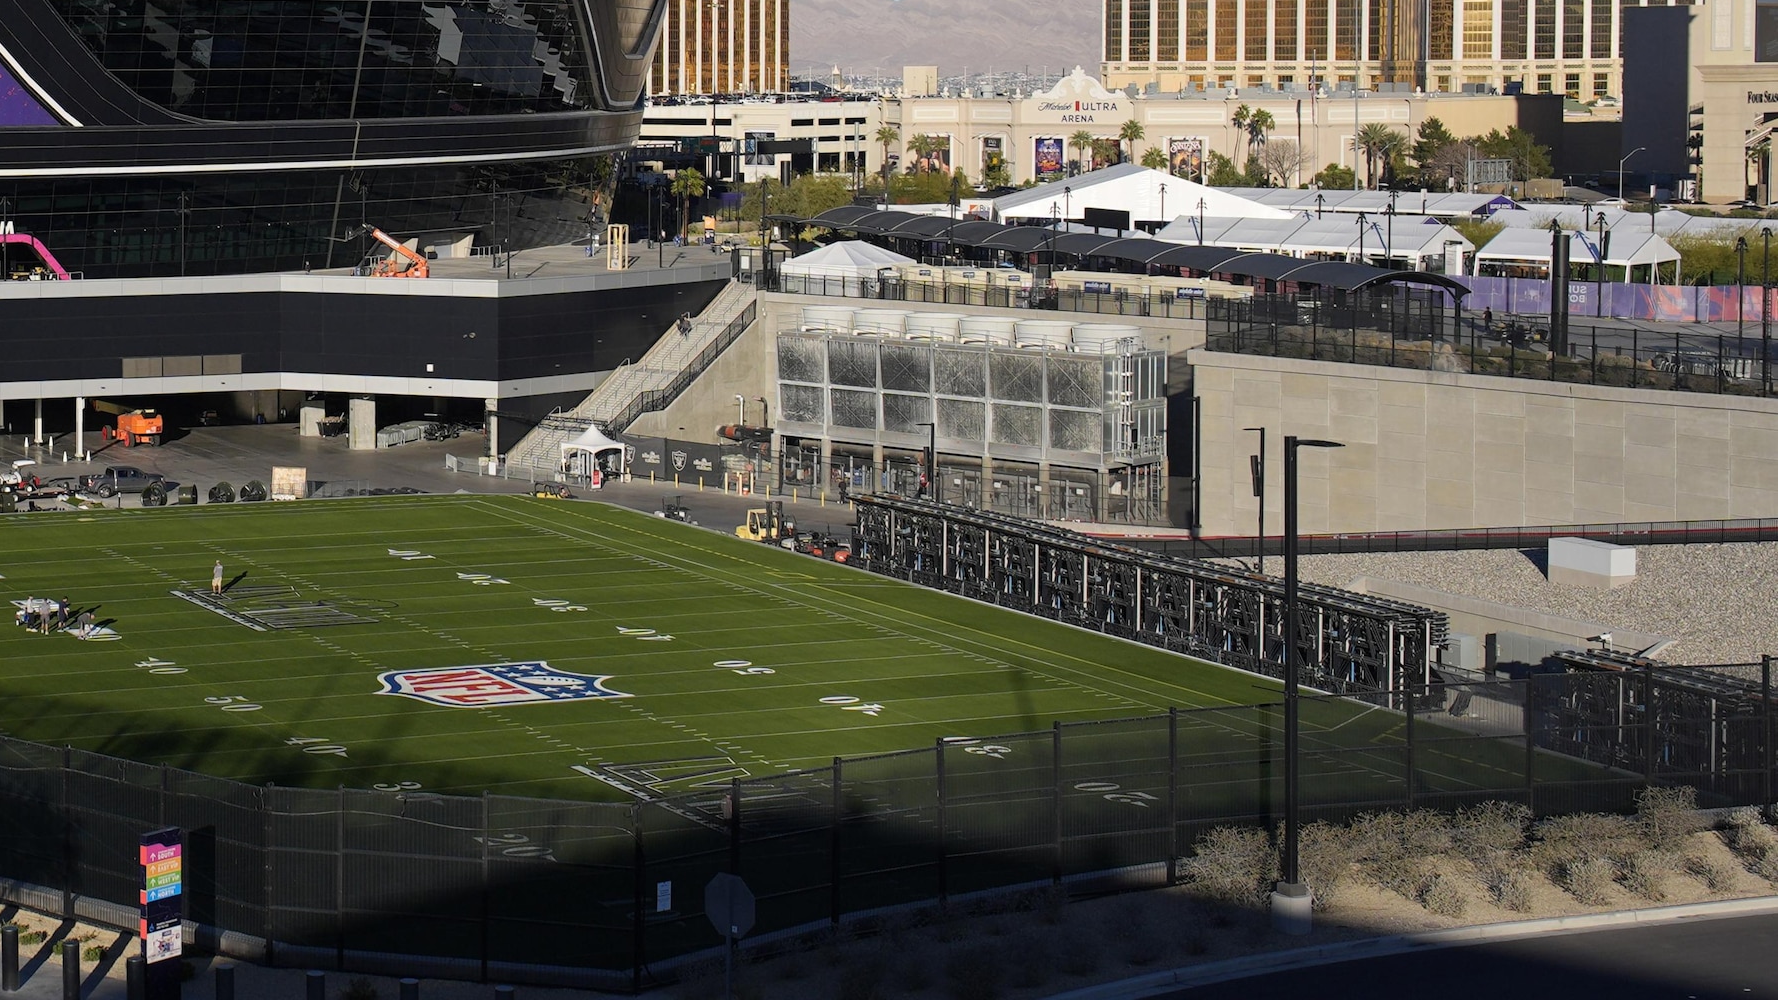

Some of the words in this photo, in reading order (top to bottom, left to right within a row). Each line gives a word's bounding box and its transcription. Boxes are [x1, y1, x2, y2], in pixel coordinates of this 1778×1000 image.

[1038, 102, 1072, 112] Michelob
[1082, 102, 1118, 111] ULTRA
[534, 600, 588, 612] 30
[619, 628, 676, 642] 40
[713, 660, 776, 676] 50
[403, 670, 530, 704] NFL
[204, 696, 263, 712] 50
[818, 696, 885, 712] 40
[158, 852, 174, 860] SOUTH
[158, 888, 174, 897] NORTH
